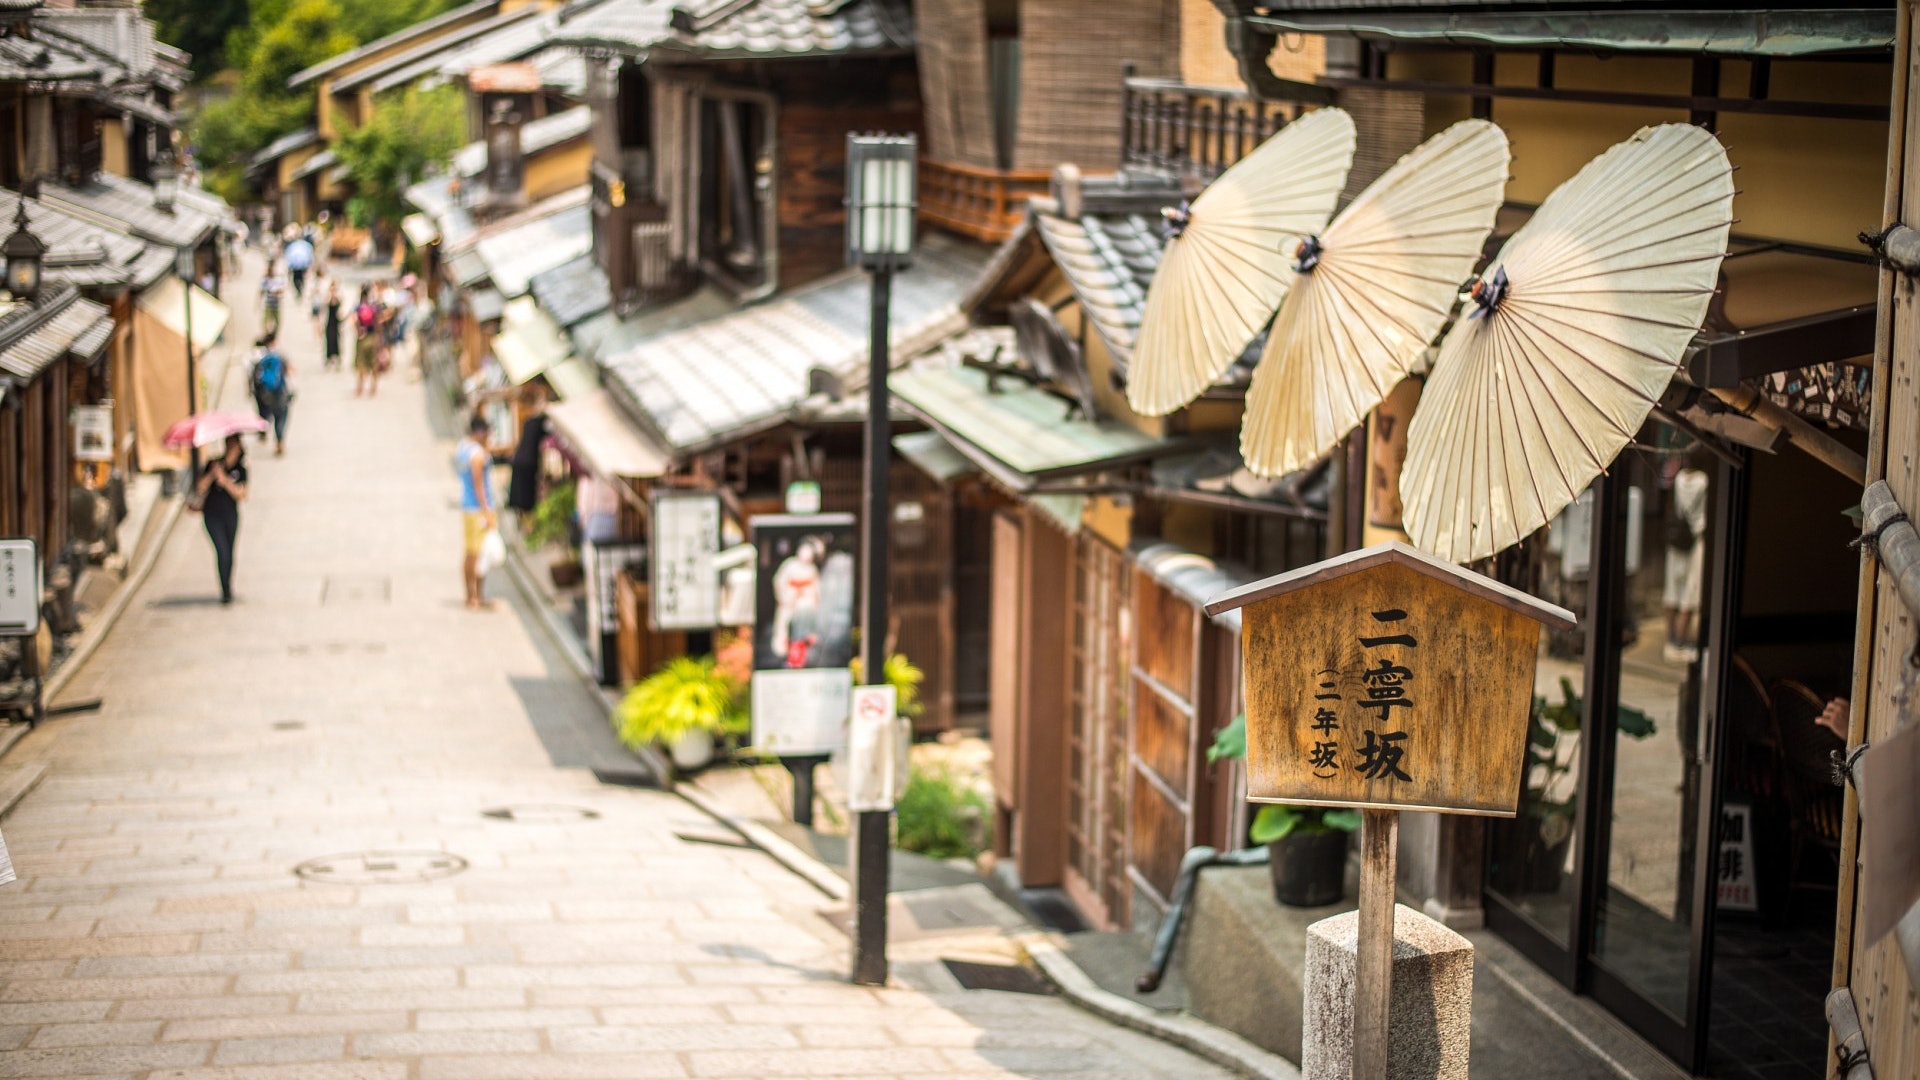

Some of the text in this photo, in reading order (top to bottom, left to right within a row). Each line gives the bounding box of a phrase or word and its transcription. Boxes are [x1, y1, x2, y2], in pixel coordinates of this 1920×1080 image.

[1309, 670, 1341, 779] （二年坂）
[1355, 609, 1417, 782] 二寧坂
